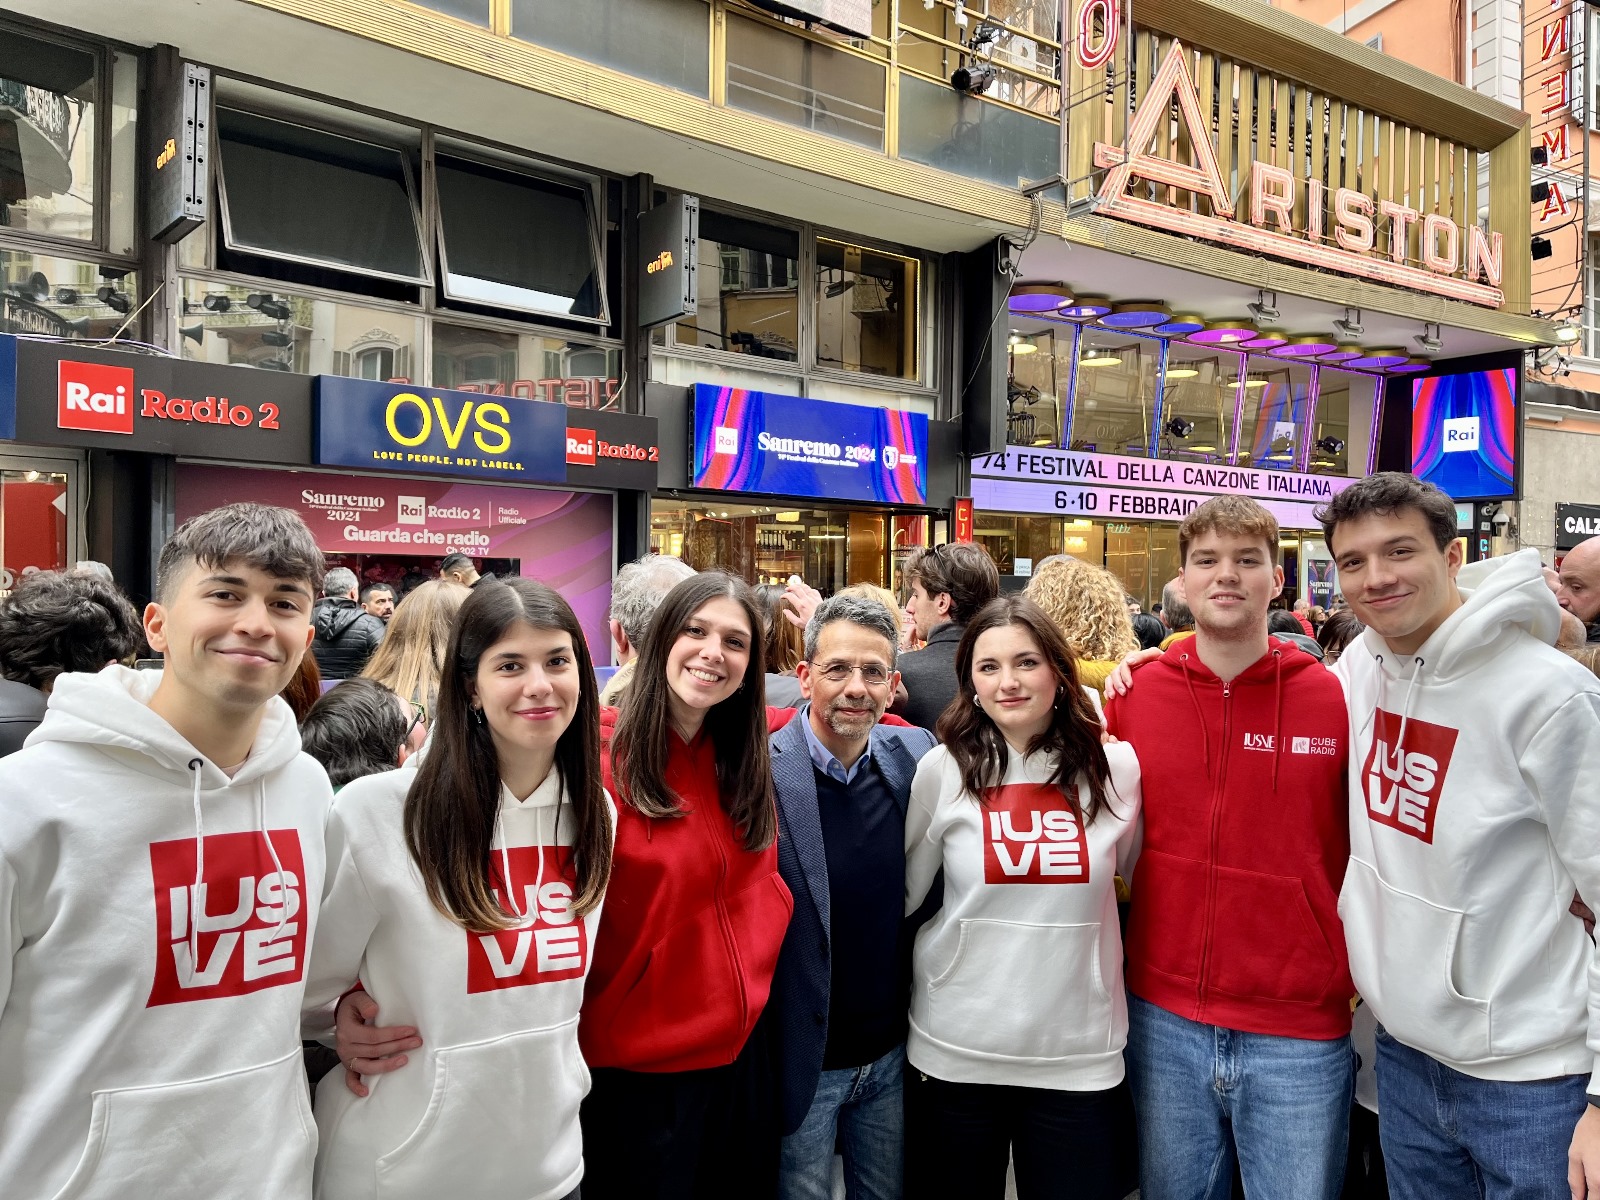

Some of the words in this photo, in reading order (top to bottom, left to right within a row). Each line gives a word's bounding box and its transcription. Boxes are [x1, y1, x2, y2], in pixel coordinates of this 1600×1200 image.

[1094, 38, 1503, 290] ARISTON
[66, 381, 126, 415] Rai
[140, 388, 254, 428] Radio
[258, 402, 280, 430] 2
[385, 393, 511, 454] OVS
[1447, 426, 1475, 442] Rai
[566, 436, 594, 457] Rai
[597, 440, 648, 461] Radio
[648, 446, 659, 462] 2
[718, 435, 735, 447] Rai
[757, 431, 841, 458] Sanremo
[845, 445, 876, 462] 2024
[373, 450, 403, 461] LOVE
[407, 453, 454, 465] PEOPLE.
[456, 457, 478, 467] NOT
[1017, 453, 1108, 479] FESTIVAL
[1117, 462, 1175, 483] DELLA
[1183, 467, 1260, 490] CANZONE
[1267, 474, 1332, 496] ITALIANA
[301, 489, 385, 508] Sanremo
[326, 510, 361, 522] 2024
[400, 503, 423, 517] Rai
[427, 505, 471, 520] Radio
[472, 508, 481, 521] 2
[498, 507, 519, 516] Radio
[498, 515, 527, 525] Ufficiale
[343, 525, 410, 543] Guarda
[412, 528, 445, 544] che
[447, 530, 490, 547] radio
[1564, 516, 1600, 535] CALZ
[445, 546, 458, 554] Ch
[478, 547, 489, 556] TV
[1243, 732, 1275, 749] IUSVE
[1310, 746, 1336, 756] RADIO
[1311, 737, 1338, 748] CUBE
[1370, 738, 1438, 793] IUS
[1368, 774, 1430, 834] VE
[989, 810, 1079, 842] IUS
[992, 842, 1082, 876] VE
[169, 870, 300, 941] IUS
[171, 921, 299, 990] VE
[478, 925, 582, 979] VE
